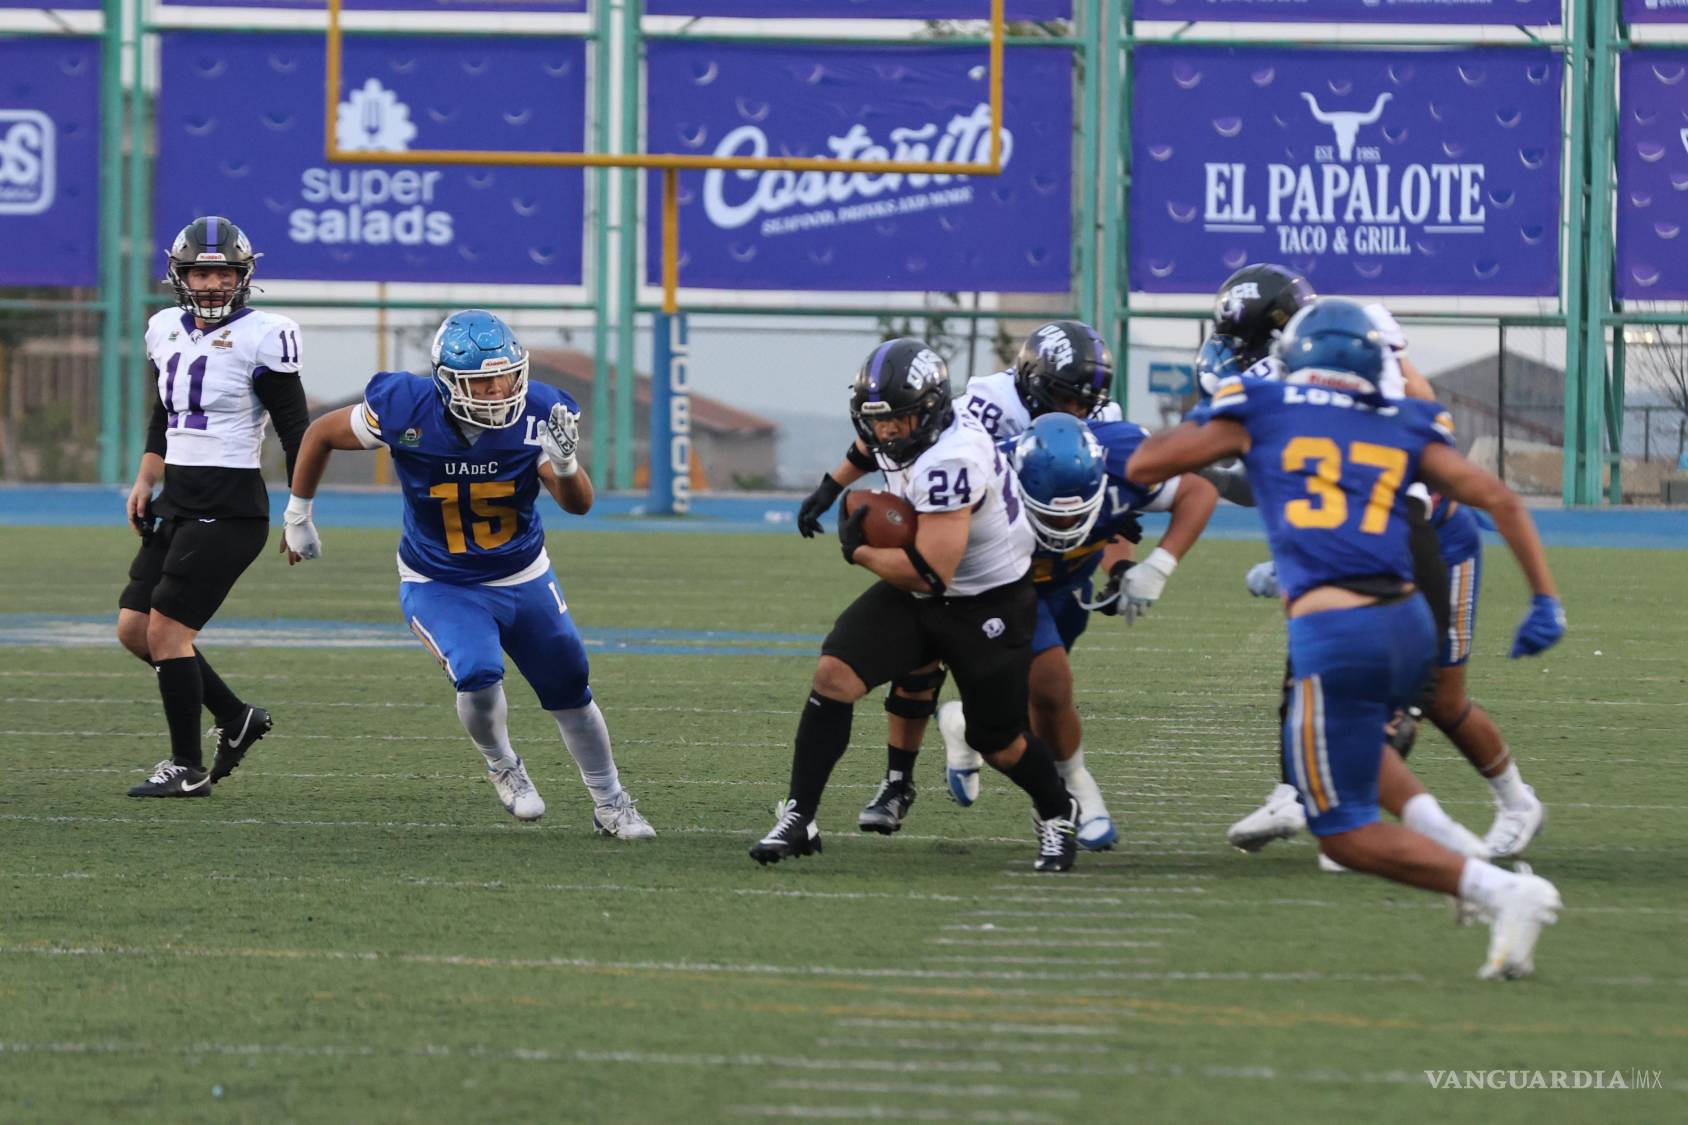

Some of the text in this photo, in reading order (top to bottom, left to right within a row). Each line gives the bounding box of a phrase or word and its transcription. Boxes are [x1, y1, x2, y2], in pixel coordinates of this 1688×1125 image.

[301, 167, 443, 207] super
[1204, 163, 1486, 224] EL PAPALOTE
[288, 204, 454, 245] salads
[1277, 225, 1411, 255] TACO & GRILL
[279, 330, 298, 363] 11
[165, 352, 209, 431] 11
[927, 467, 971, 506] 24
[1282, 437, 1408, 534] 37
[429, 480, 519, 554] 15
